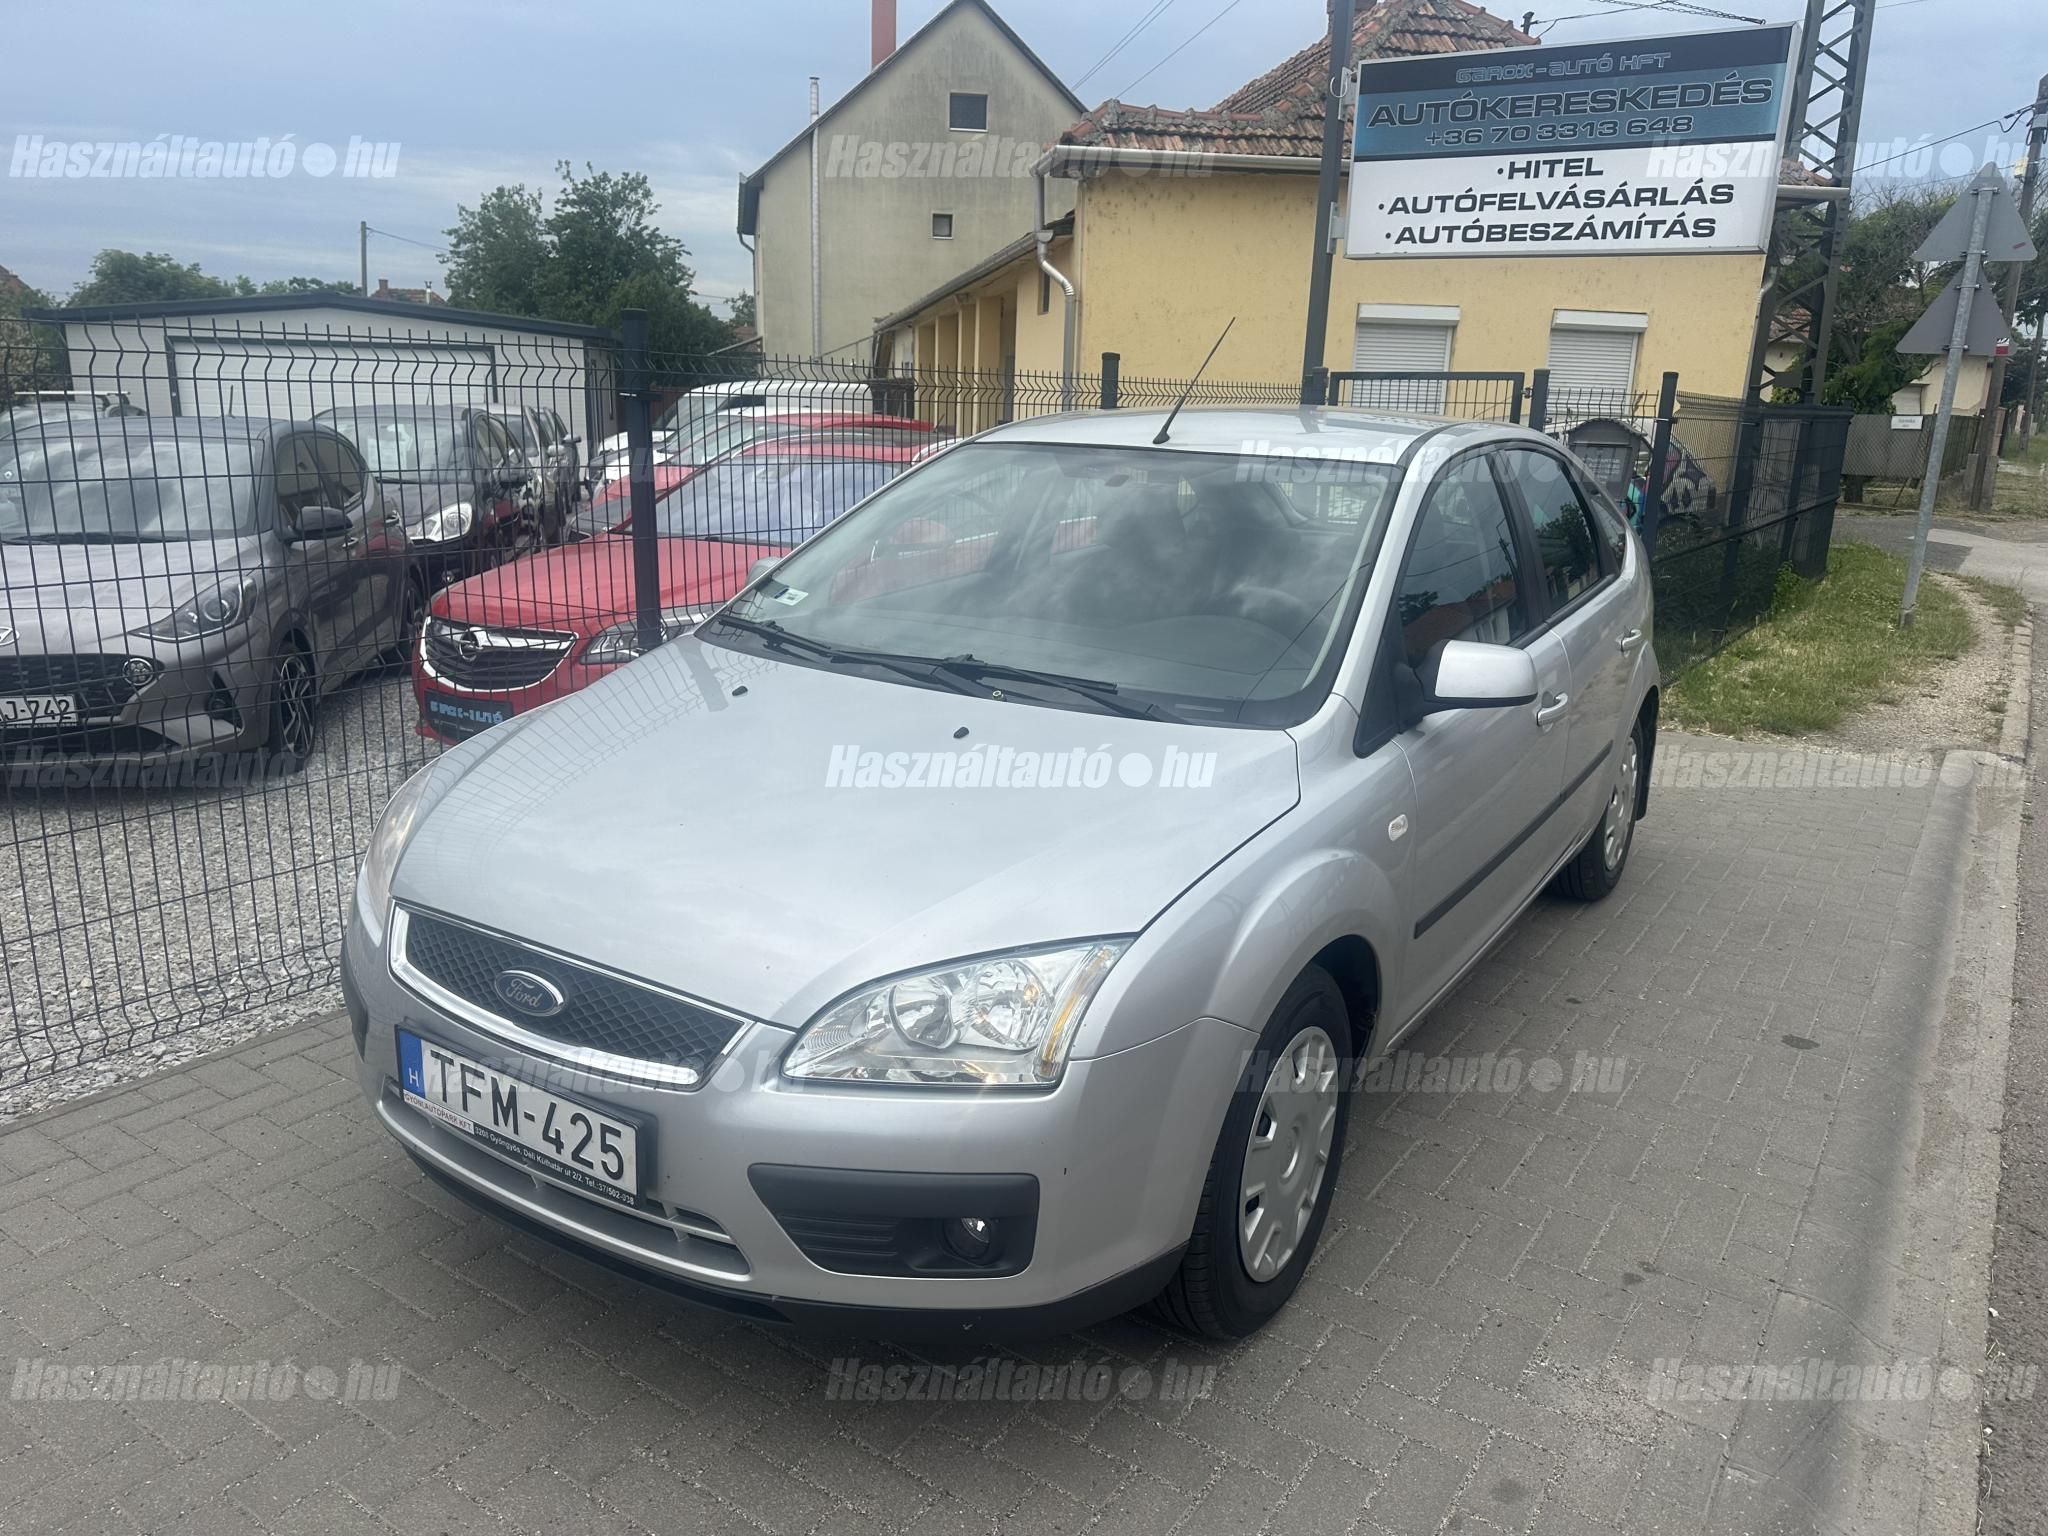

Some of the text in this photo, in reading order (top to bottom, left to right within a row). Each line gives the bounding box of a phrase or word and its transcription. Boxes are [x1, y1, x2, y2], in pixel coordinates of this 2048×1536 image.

[1367, 70, 1773, 128] AUTÓKERESKEDÉS
[1425, 115, 1694, 146] +36 70 3313 648
[1508, 157, 1604, 180] HITEL
[1388, 178, 1734, 215] AUTÓFELVÁSÁRLÁS
[1395, 212, 1716, 245] AUTÓBESZÁMÍTÁS
[0, 699, 72, 721] J-742
[505, 978, 543, 1008] Ford
[408, 1066, 420, 1089] H
[430, 1050, 624, 1181] TFM-425
